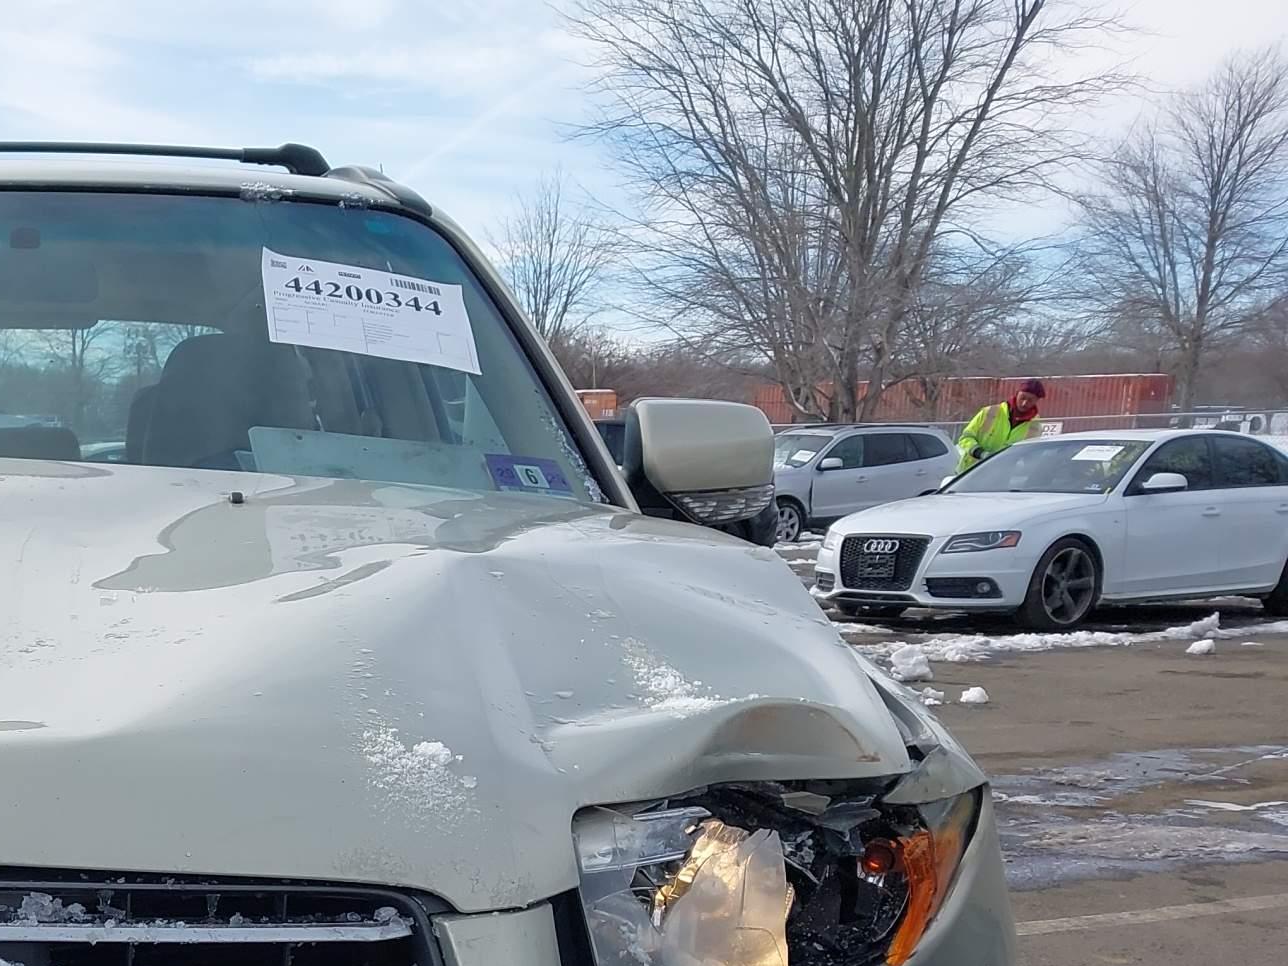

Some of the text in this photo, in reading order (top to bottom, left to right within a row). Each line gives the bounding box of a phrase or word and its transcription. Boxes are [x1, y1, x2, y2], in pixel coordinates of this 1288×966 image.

[273, 289, 321, 302] Progressive
[361, 301, 400, 314] Insurance
[284, 275, 443, 316] 44200344
[525, 468, 539, 485] 6
